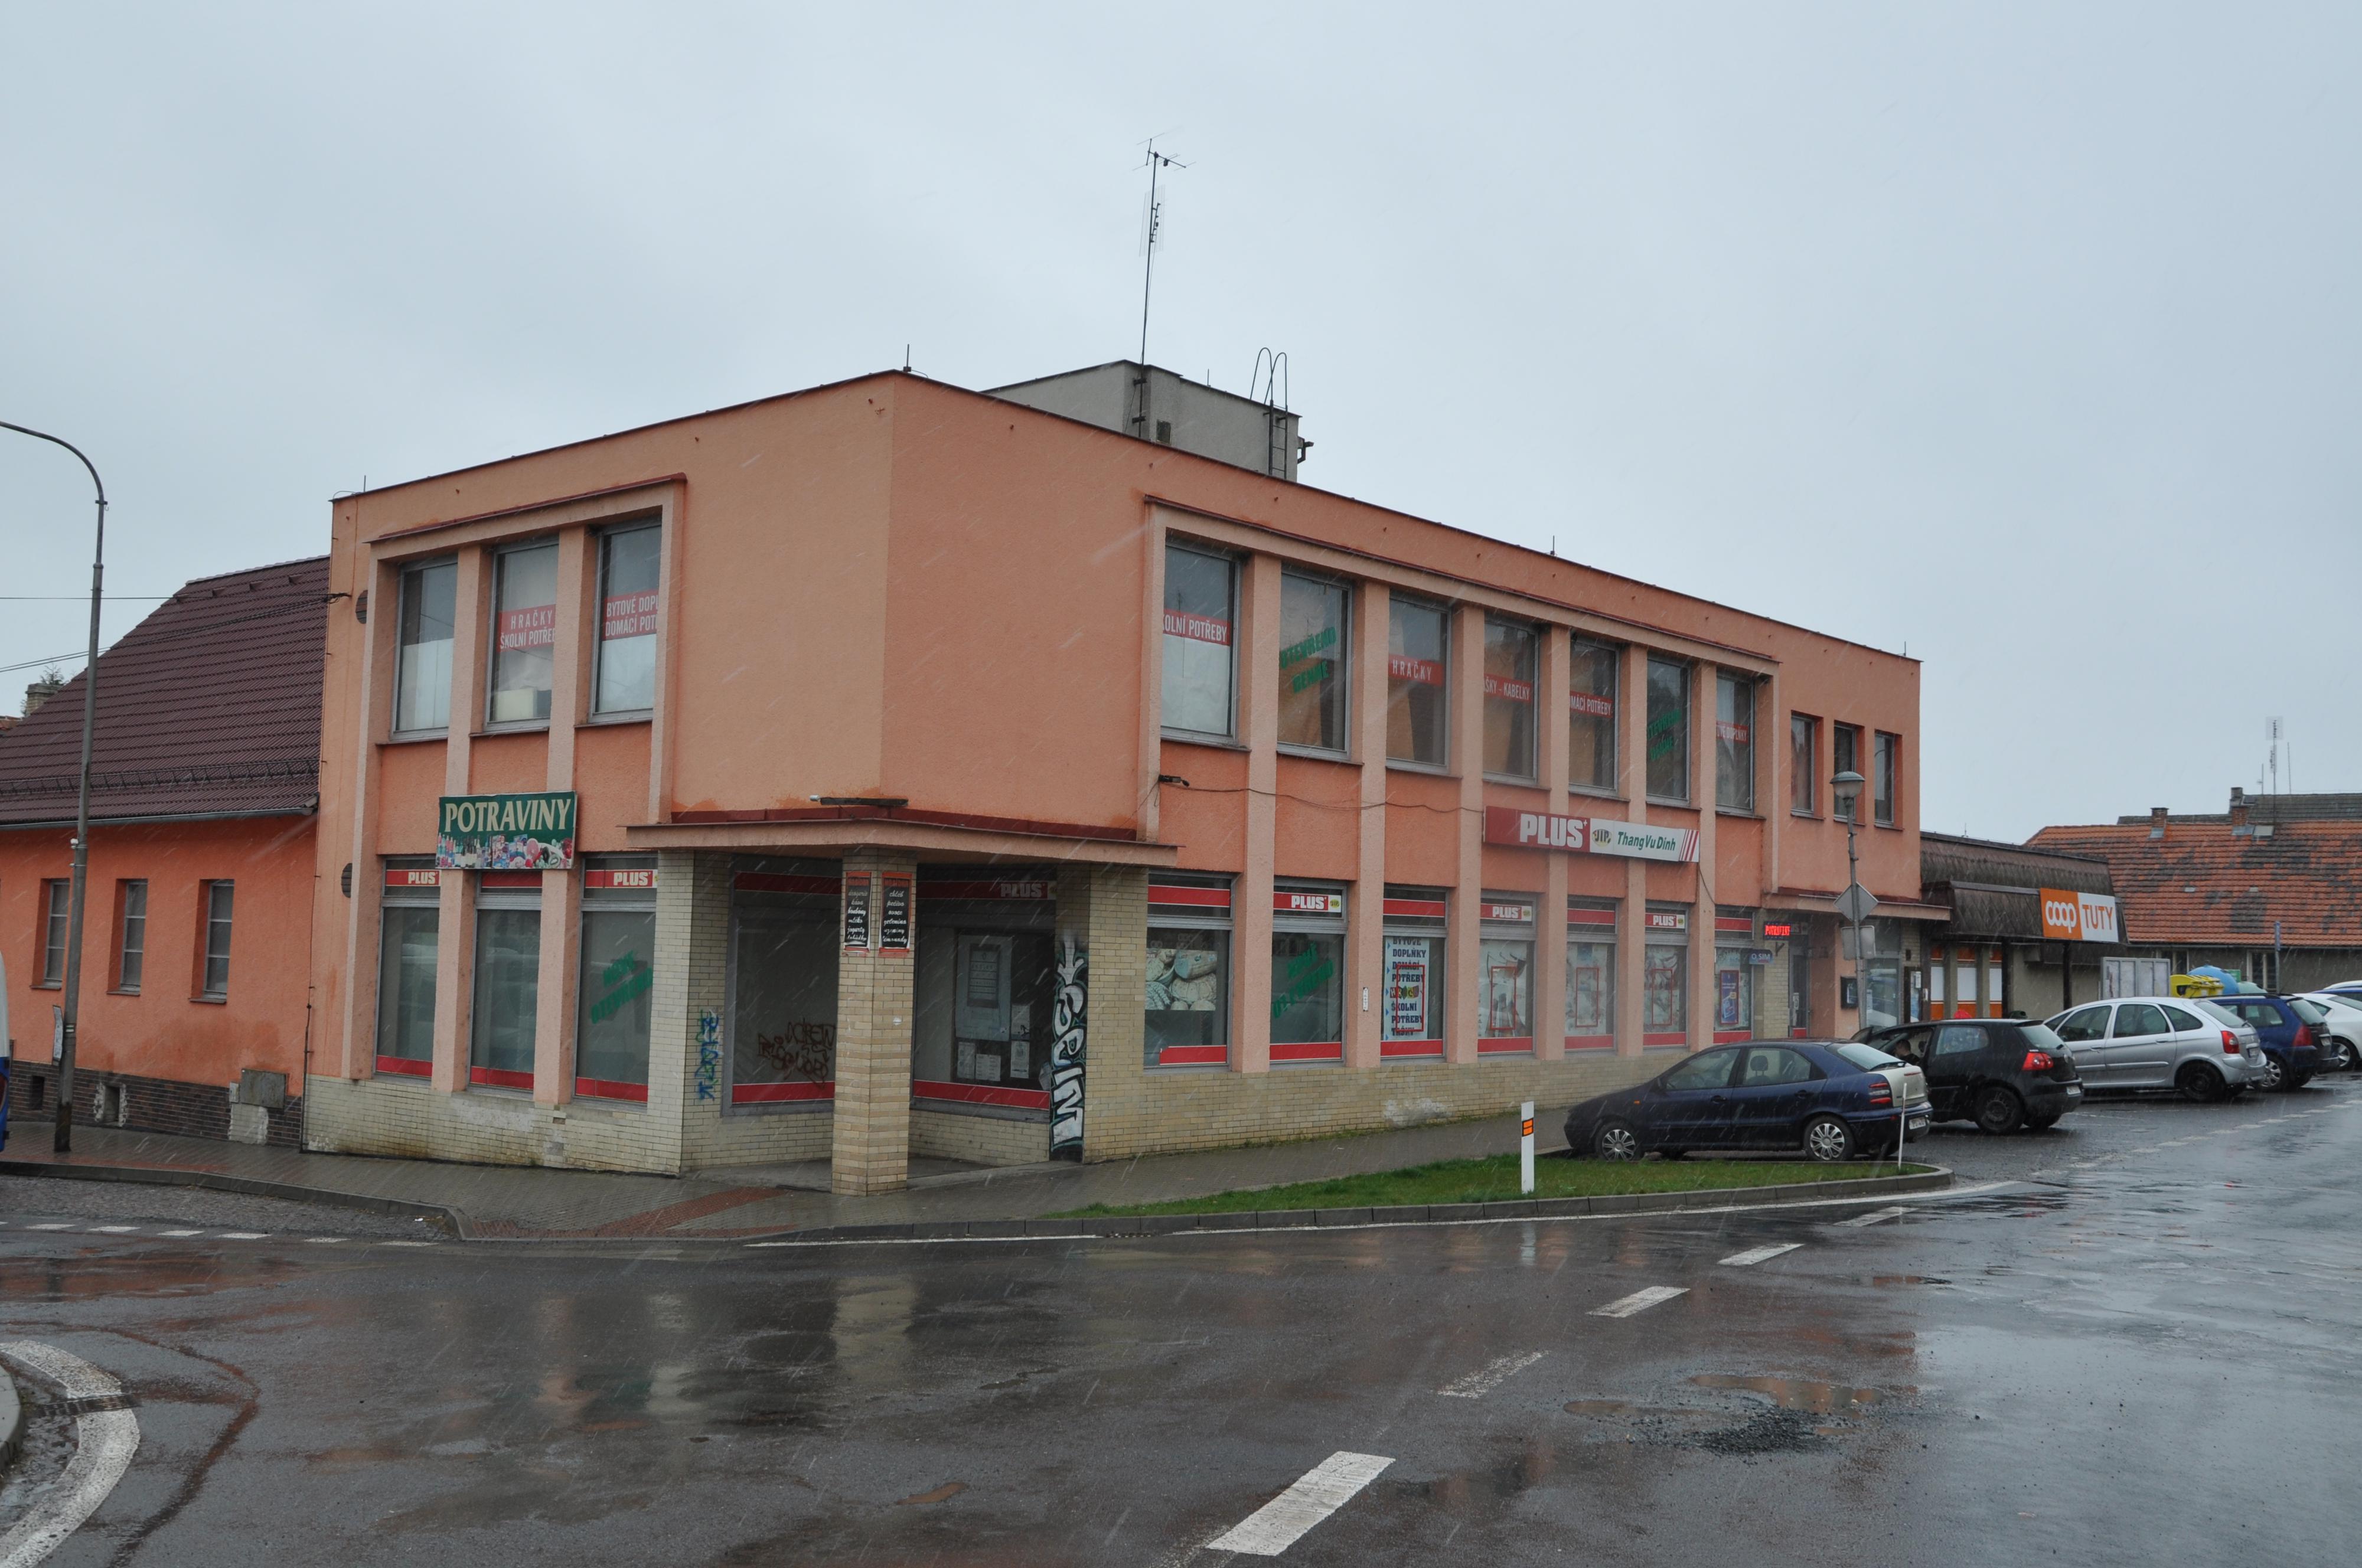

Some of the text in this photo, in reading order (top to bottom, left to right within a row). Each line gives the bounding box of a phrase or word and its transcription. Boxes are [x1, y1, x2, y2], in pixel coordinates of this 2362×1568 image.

[607, 596, 637, 617] BYTOVÉ
[511, 609, 552, 630] HRAČKY
[605, 614, 657, 636] DOMÁCÍ POT
[1163, 615, 1227, 642] OLNÍ POTŘEBY
[500, 629, 527, 649] ŠKOLNÍ
[1393, 659, 1431, 681] HRAČKY
[1484, 676, 1498, 694] ŠKY
[1503, 682, 1531, 700] KABELKY
[1570, 694, 1611, 716] MÁCÍ POTŘEBY
[444, 799, 571, 832] POTRAVINY
[1617, 831, 1645, 850] Thang
[1645, 835, 1656, 849] Vu
[1656, 836, 1676, 851] Dinh
[2082, 904, 2113, 930] TUTY
[1392, 948, 1426, 958] DOPLŇKY
